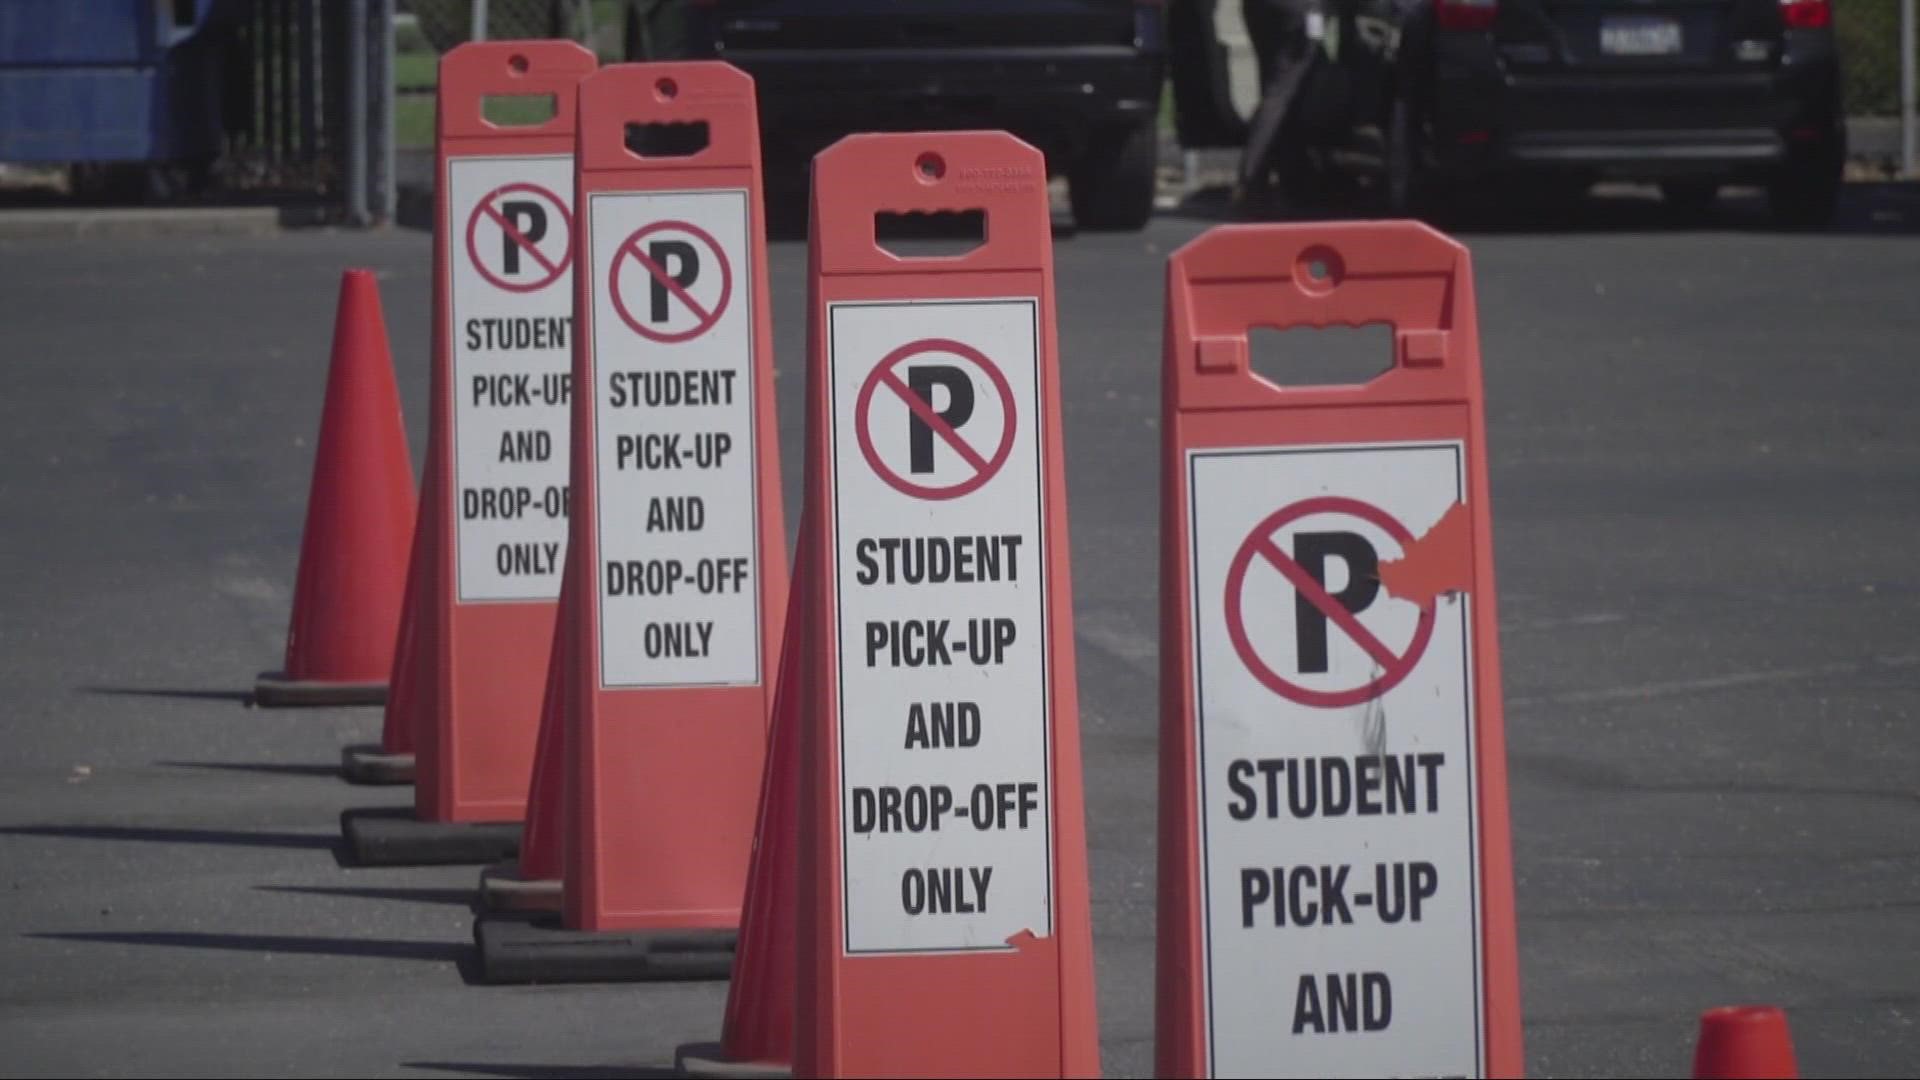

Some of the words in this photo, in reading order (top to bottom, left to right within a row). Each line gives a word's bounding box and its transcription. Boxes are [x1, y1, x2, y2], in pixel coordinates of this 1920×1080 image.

[650, 240, 700, 323] P
[610, 370, 736, 408] STUDENT
[908, 365, 976, 474] P
[499, 430, 551, 462] AND
[617, 432, 732, 470] PICK-UP
[463, 485, 570, 520] DROP-O
[646, 496, 705, 532] AND
[497, 543, 559, 576] ONLY
[607, 558, 748, 596] DROP-OFF
[856, 535, 1023, 586] STUDENT
[1293, 530, 1380, 674] P
[644, 621, 713, 659] ONLY
[865, 618, 1017, 668] PICK-UP
[904, 701, 981, 750] AND
[852, 782, 1038, 834] DROP-OFF
[1227, 752, 1445, 822] STUDENT
[901, 867, 993, 916] ONLY
[1240, 861, 1438, 929] PICK-UP
[1291, 971, 1393, 1035] AND
